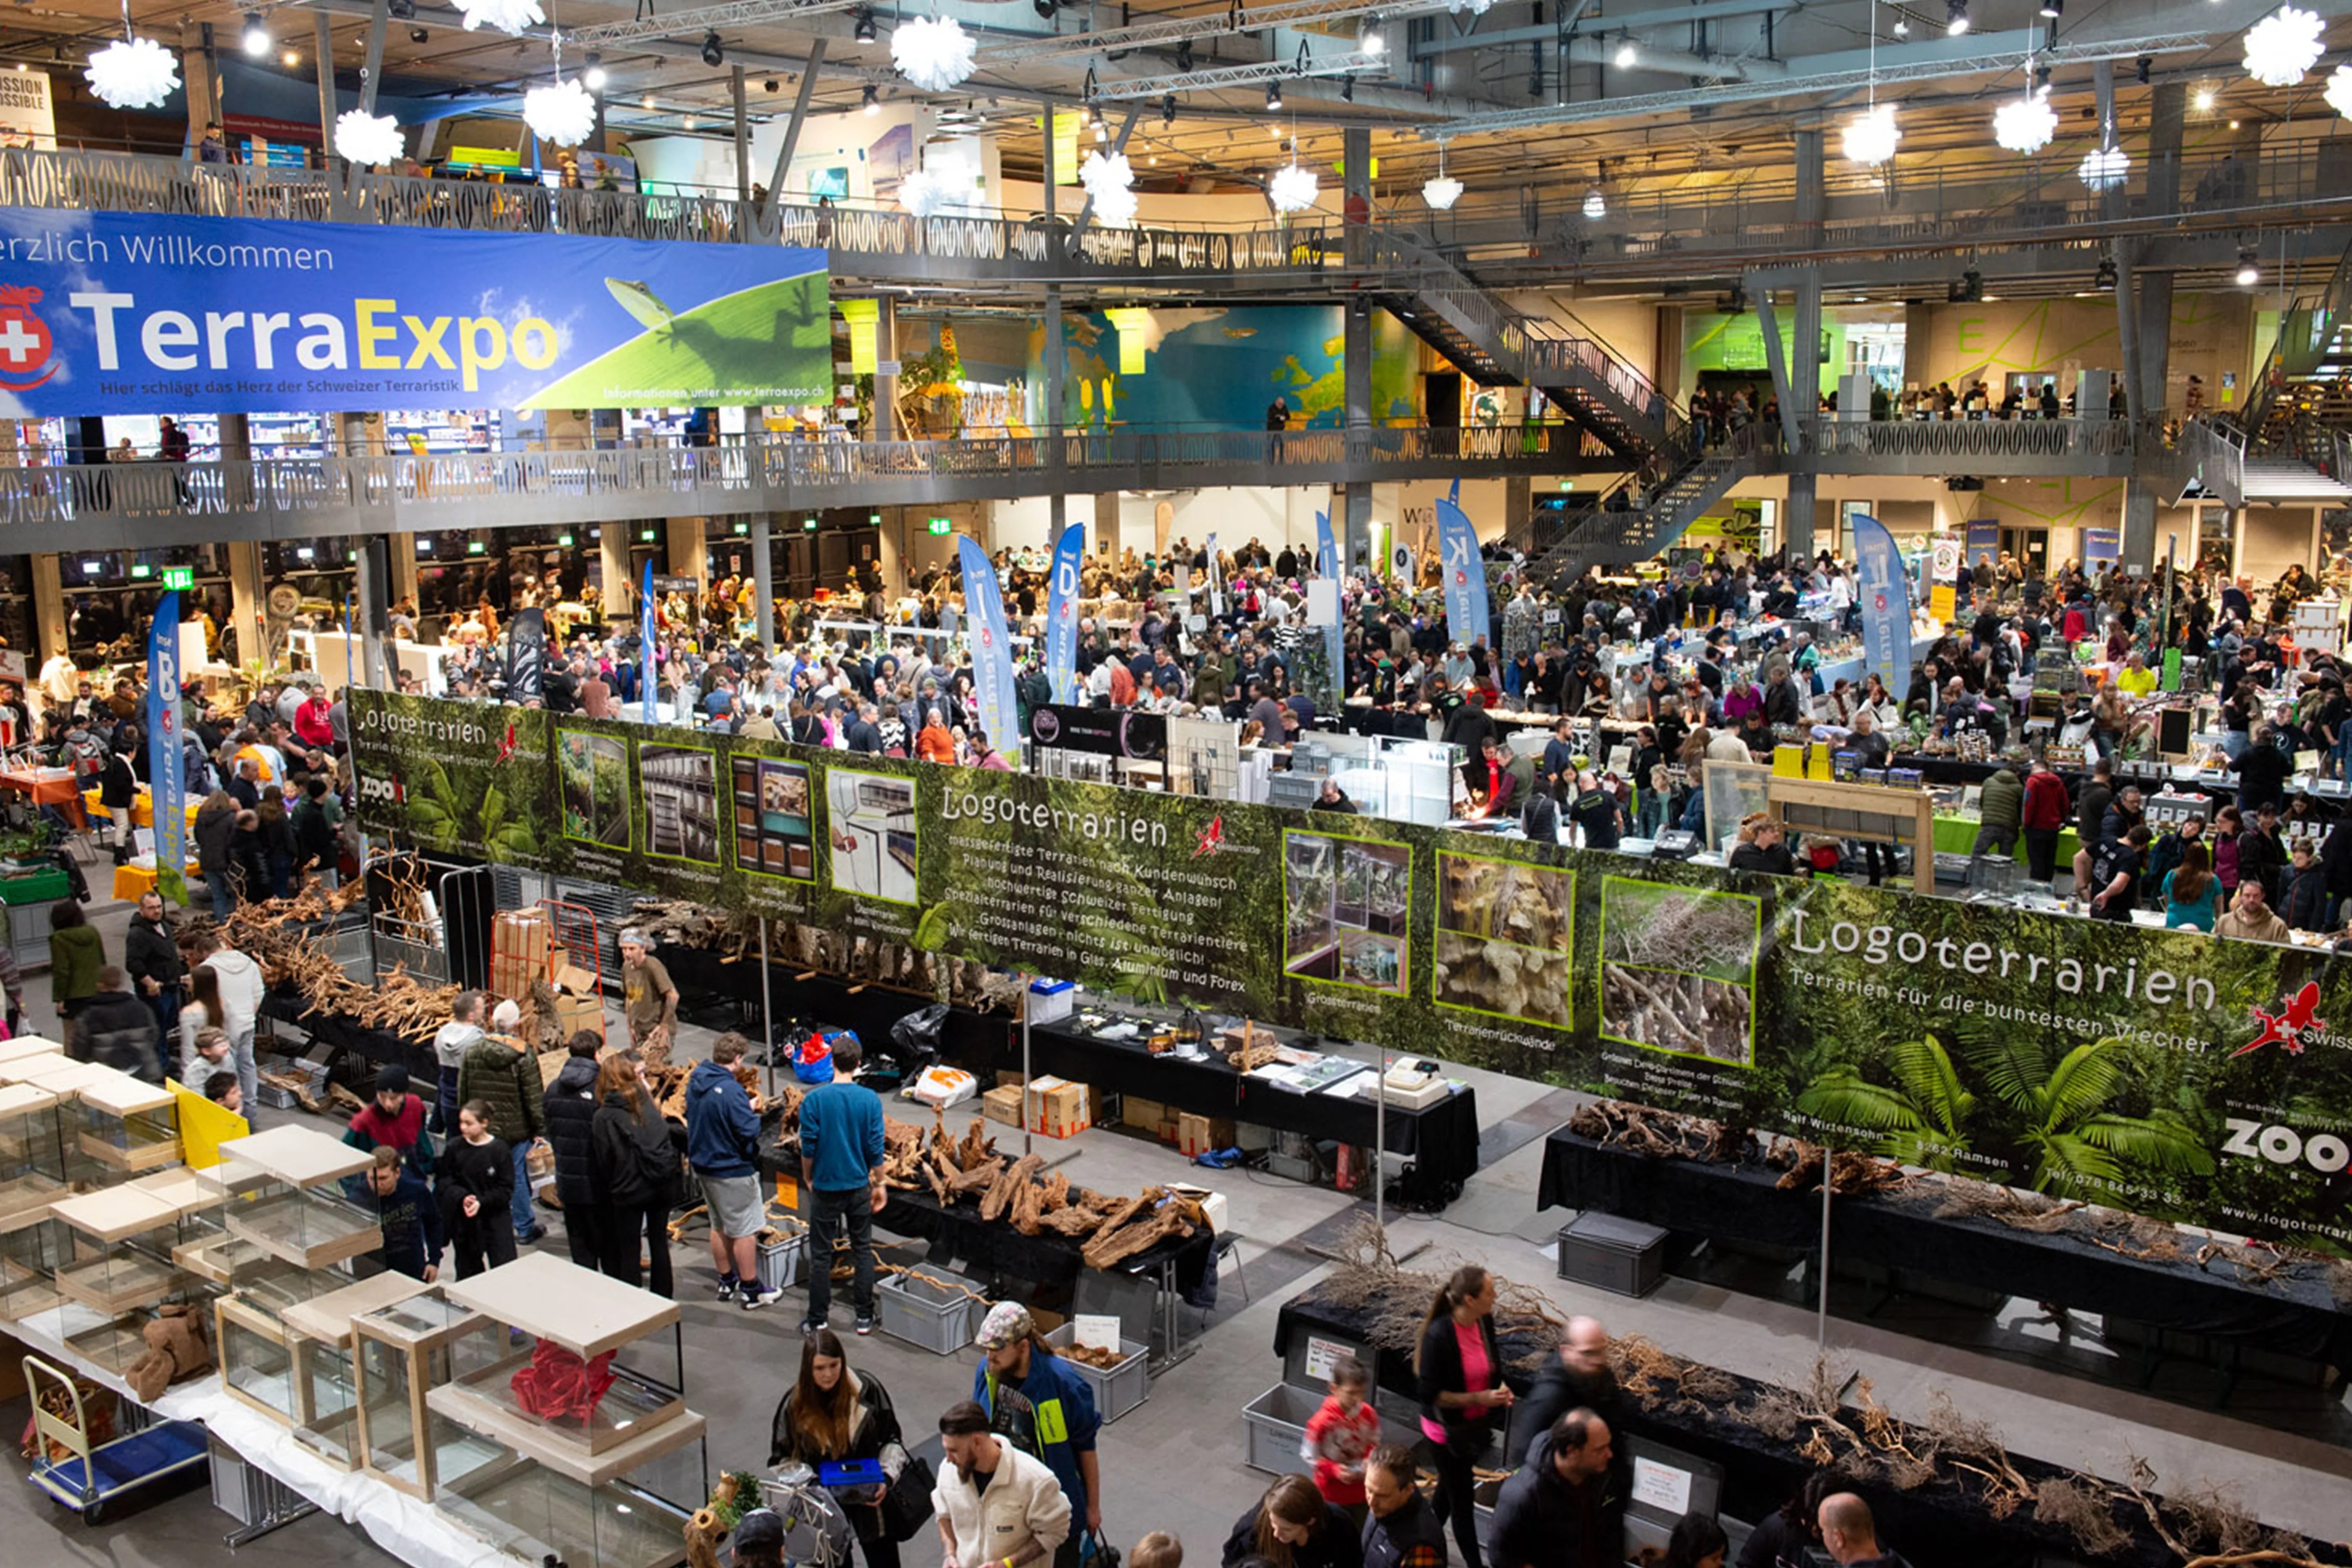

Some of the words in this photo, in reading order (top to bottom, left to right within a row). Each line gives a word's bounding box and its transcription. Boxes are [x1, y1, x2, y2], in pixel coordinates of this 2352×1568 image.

[121, 235, 334, 270] Willkommen
[69, 292, 558, 392] TerraExpo
[101, 381, 136, 395] Hier
[142, 380, 202, 397] schlägt
[206, 380, 232, 394] das
[237, 380, 272, 394] Herz
[277, 380, 302, 393] der
[306, 380, 379, 393] Schweizer
[384, 380, 459, 392] Terraristik
[604, 385, 687, 398] Informationen
[691, 388, 719, 398] unter
[724, 385, 824, 400] www.terraexpo.ch
[1059, 562, 1076, 597] D
[158, 651, 176, 701] B
[163, 740, 180, 864] TerraExpo
[942, 786, 1167, 847] Logoterrarien
[963, 853, 1007, 873] Planung
[1011, 863, 1032, 876] und
[1036, 865, 1112, 891] Realisierung
[1116, 881, 1158, 898] ganzer
[1036, 847, 1095, 867] Terrarien
[1101, 860, 1130, 874] nach
[1135, 864, 1237, 891] Kundenwunsch
[945, 887, 1035, 914] Spezialterrarien
[1061, 910, 1146, 934] verschiedene
[1150, 925, 1248, 952] Terrarientiere
[987, 876, 1057, 900] hochwertige
[1061, 890, 1127, 911] Schweizer
[1131, 902, 1194, 925] Fertigung
[980, 912, 1056, 937] Grossanlagen
[1066, 931, 1105, 948] nichts
[1110, 936, 1128, 951] ist
[1134, 943, 1205, 966] unmöglich!
[1011, 937, 1063, 958] Terrarien
[1066, 946, 1077, 961] in
[1112, 958, 1179, 981] Aluminium
[1183, 972, 1207, 985] und
[1210, 975, 1246, 993] Forex
[1790, 908, 2216, 1011] Logoterrarien
[1445, 1018, 1556, 1051] Terrarienrückwände
[1789, 968, 1889, 998] Terrarien
[1897, 986, 1931, 1006] für
[1940, 994, 1975, 1013] die
[1984, 1000, 2104, 1035] buntesten
[2113, 1020, 2211, 1054] Viecher
[1782, 1110, 1807, 1125] Ralf
[1810, 1118, 1884, 1142] Wirtensohn
[1916, 1141, 1949, 1156] 8262
[1954, 1148, 2009, 1168] Ramsen
[2076, 1175, 2102, 1188] 078
[2108, 1182, 2134, 1195] 845
[2140, 1188, 2159, 1200] 33
[2164, 1193, 2183, 1205] 33
[2221, 1118, 2352, 1173] zoo
